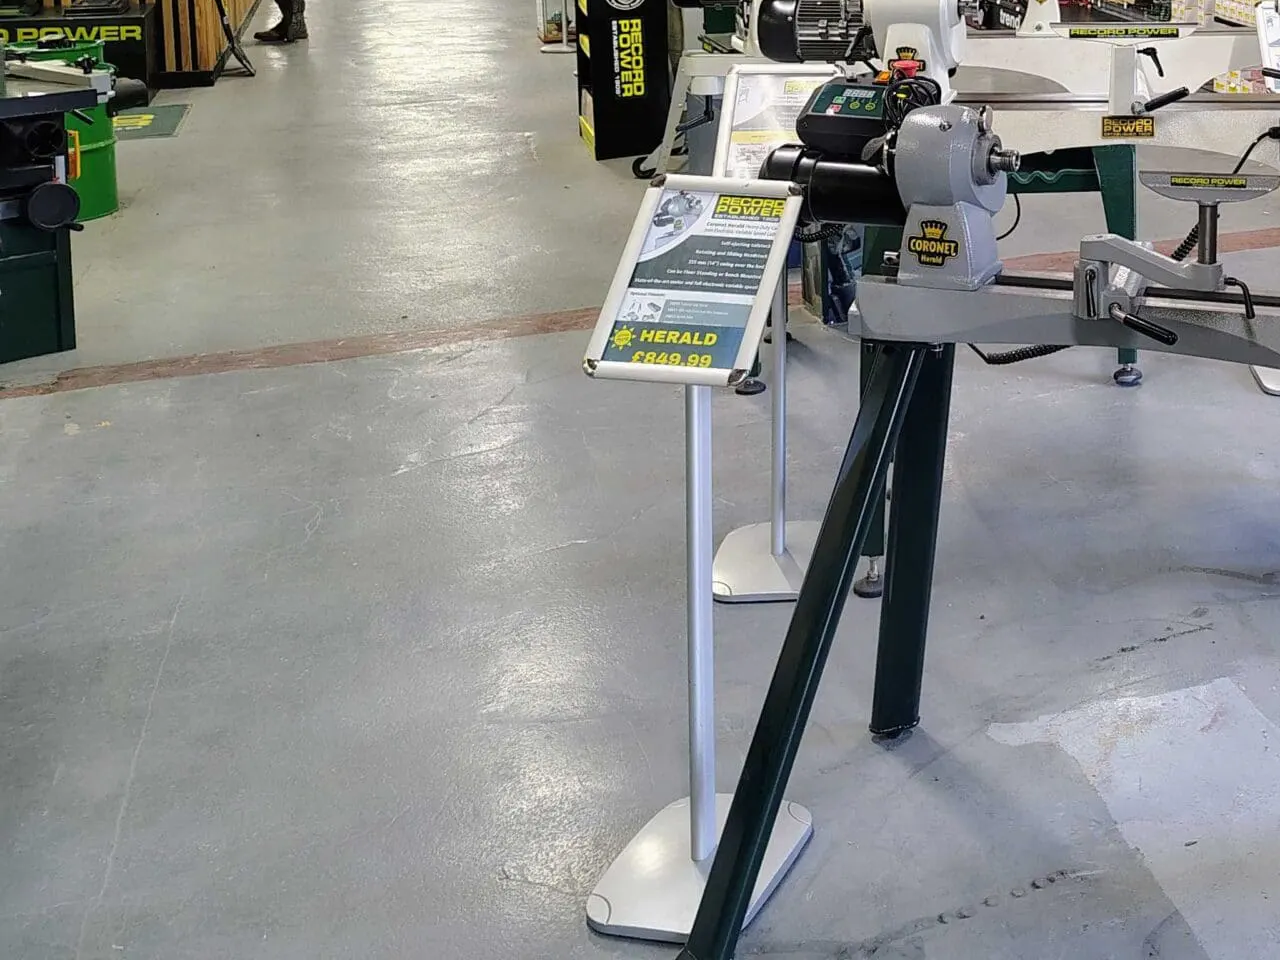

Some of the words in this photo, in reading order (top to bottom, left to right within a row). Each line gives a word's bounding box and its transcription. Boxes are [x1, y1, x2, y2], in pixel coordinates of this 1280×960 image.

[17, 25, 142, 43] POWER
[618, 19, 634, 97] POWER
[630, 19, 645, 95] RECORD
[1103, 118, 1152, 126] RECORD
[1103, 125, 1152, 133] POWER
[1171, 177, 1209, 185] RECORD
[1210, 178, 1246, 186] POWER
[719, 196, 785, 208] RECORD
[717, 205, 784, 217] POWER
[910, 239, 957, 256] CORONET
[640, 329, 718, 346] HERALD
[631, 350, 712, 368] £849.99
